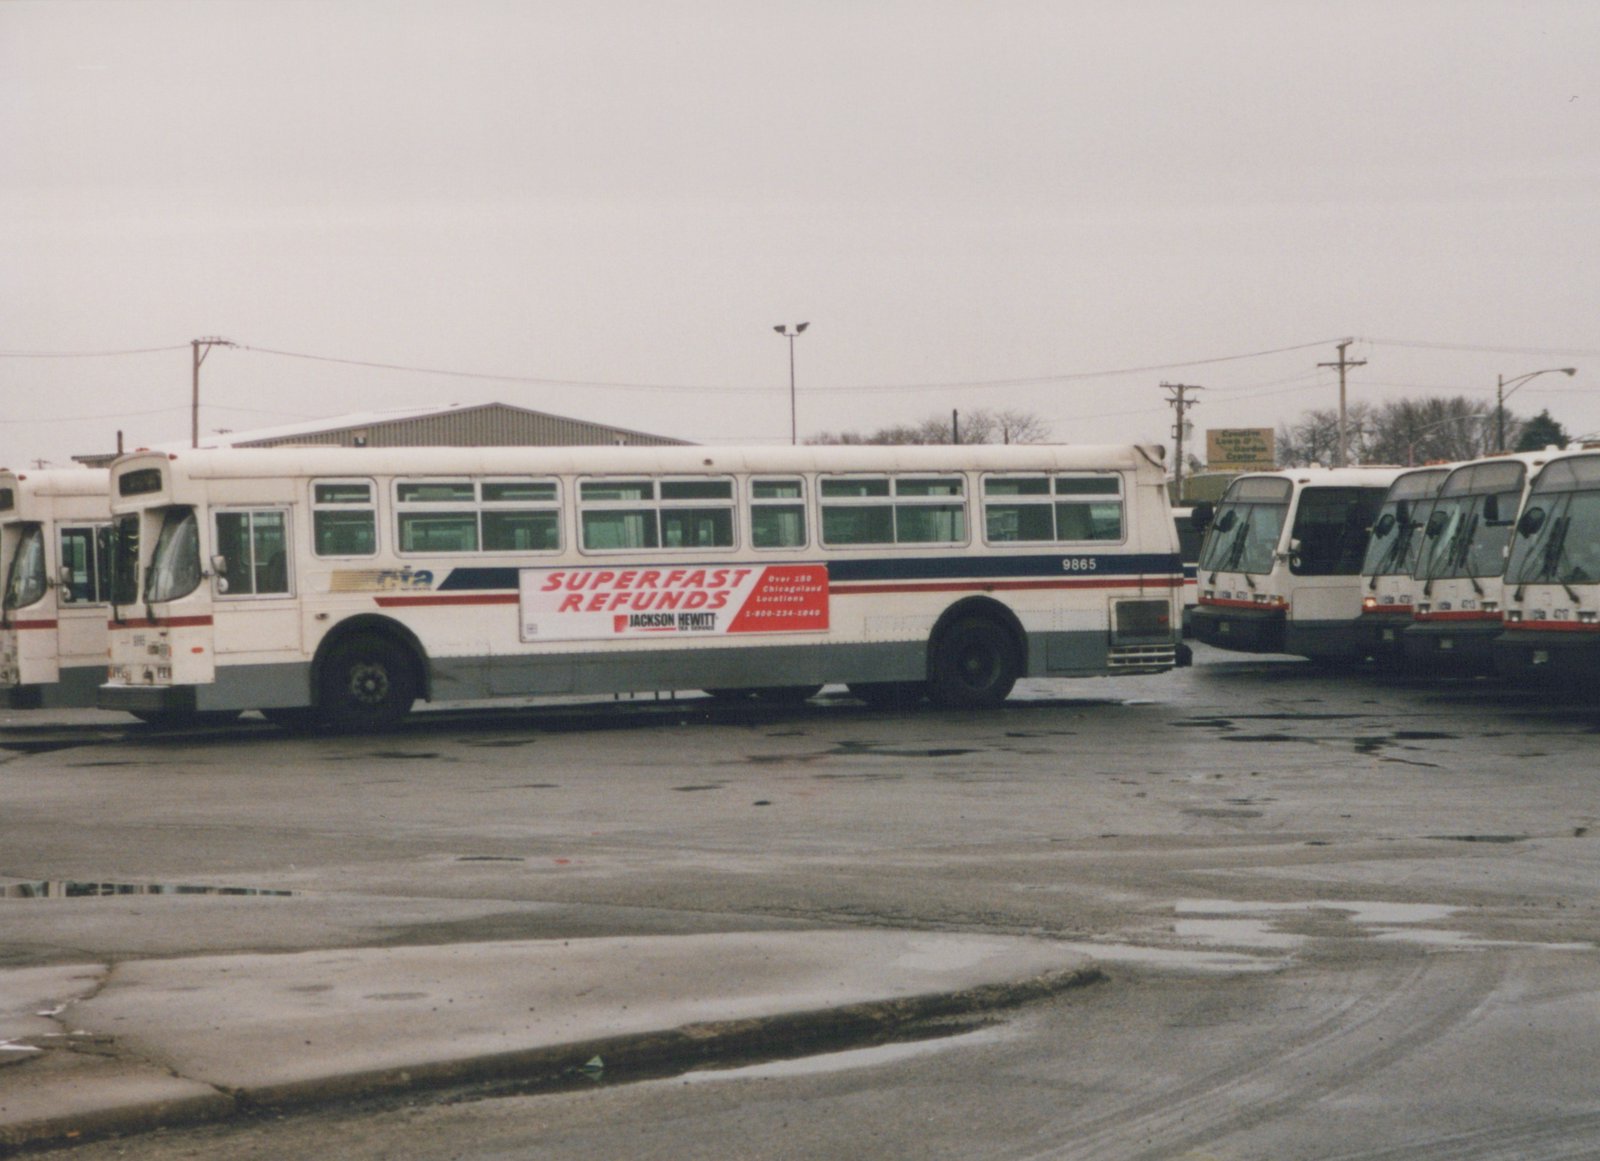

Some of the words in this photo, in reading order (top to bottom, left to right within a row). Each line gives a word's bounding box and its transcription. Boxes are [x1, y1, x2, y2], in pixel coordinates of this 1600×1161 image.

[1215, 437, 1241, 445] Lawn
[1233, 445, 1267, 453] Garden
[1225, 452, 1257, 461] Center
[1062, 558, 1097, 570] 9865
[540, 569, 752, 592] SUPERFAST
[768, 574, 791, 583] Over
[762, 584, 823, 594] Chicagoland
[557, 590, 731, 612] REFUNDS
[755, 595, 804, 604] Locations
[629, 613, 675, 627] JACKSON
[678, 612, 716, 626] HEWITT
